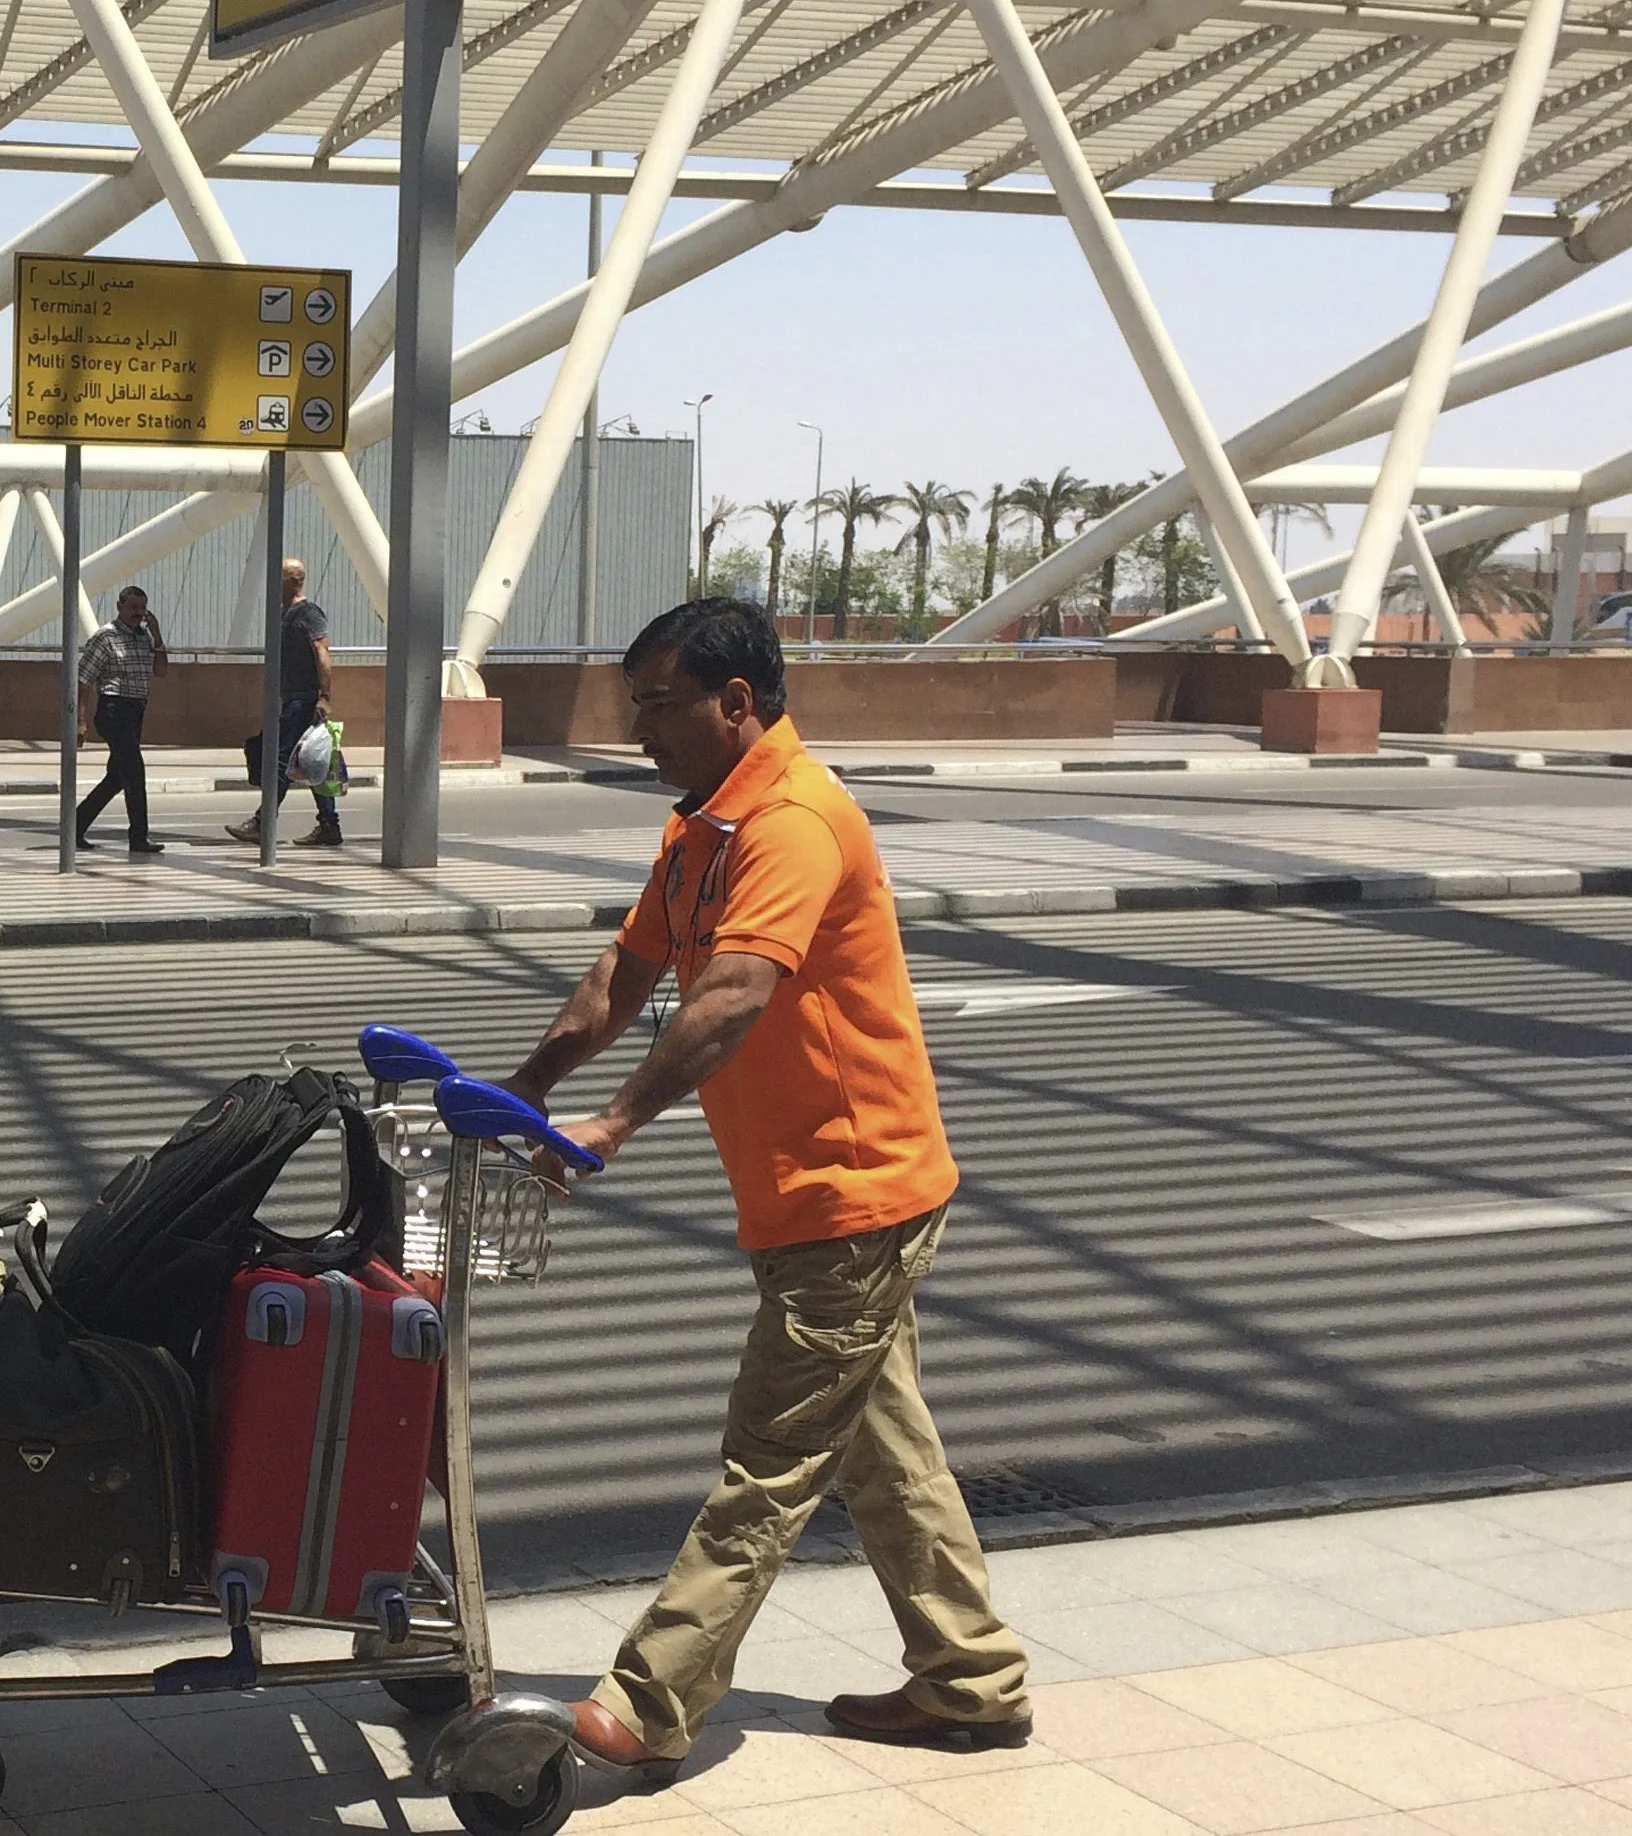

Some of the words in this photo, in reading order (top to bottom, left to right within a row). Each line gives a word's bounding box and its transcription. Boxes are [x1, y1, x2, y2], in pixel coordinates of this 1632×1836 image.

[31, 297, 97, 315] Terminal
[103, 302, 112, 316] 2
[28, 325, 83, 346] الطوابق
[27, 353, 65, 369] Multi
[71, 354, 122, 375] Storey
[128, 357, 156, 372] Car
[162, 358, 198, 374] Park
[269, 352, 282, 373] P
[26, 381, 35, 397] ٤
[40, 383, 67, 402] رقم
[106, 383, 146, 404] الناقل
[150, 384, 193, 402] محطة
[26, 410, 78, 429] People
[84, 412, 131, 428] Mover
[137, 413, 192, 430] Station
[196, 416, 207, 430] 4
